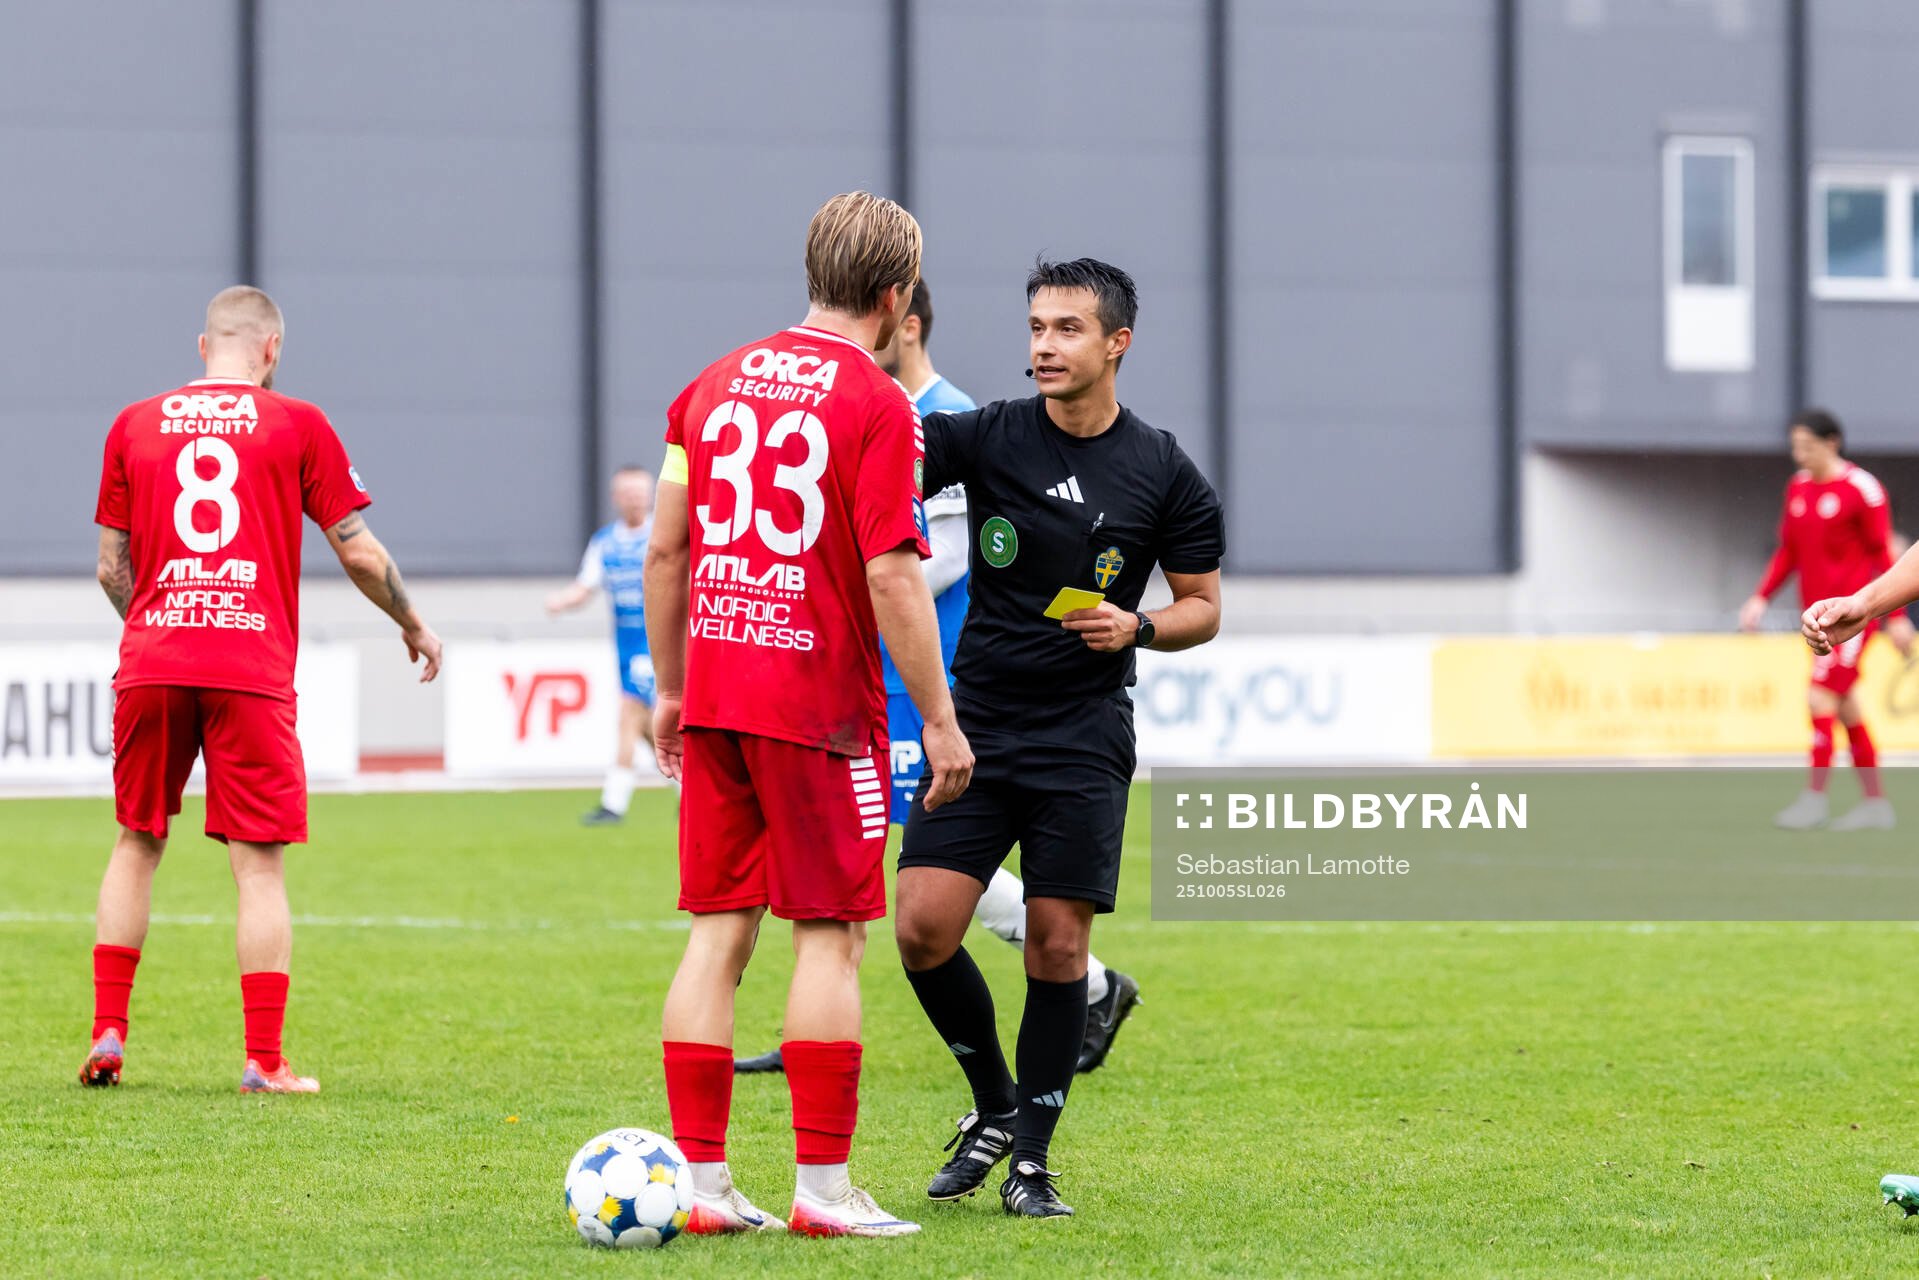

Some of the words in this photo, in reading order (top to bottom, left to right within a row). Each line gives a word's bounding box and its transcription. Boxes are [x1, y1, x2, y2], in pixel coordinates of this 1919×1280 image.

[740, 348, 839, 391] ORCA
[161, 394, 258, 419] ORCA
[728, 378, 827, 407] SECURITY
[160, 419, 258, 434] SECURITY
[696, 400, 829, 556] 33
[173, 436, 240, 553] 8
[992, 531, 1005, 553] S
[165, 590, 245, 610] NORDIC
[697, 593, 791, 625] NORDIC
[145, 610, 266, 631] WELLNESS
[504, 672, 588, 741] YP
[1126, 664, 1343, 757] aryou
